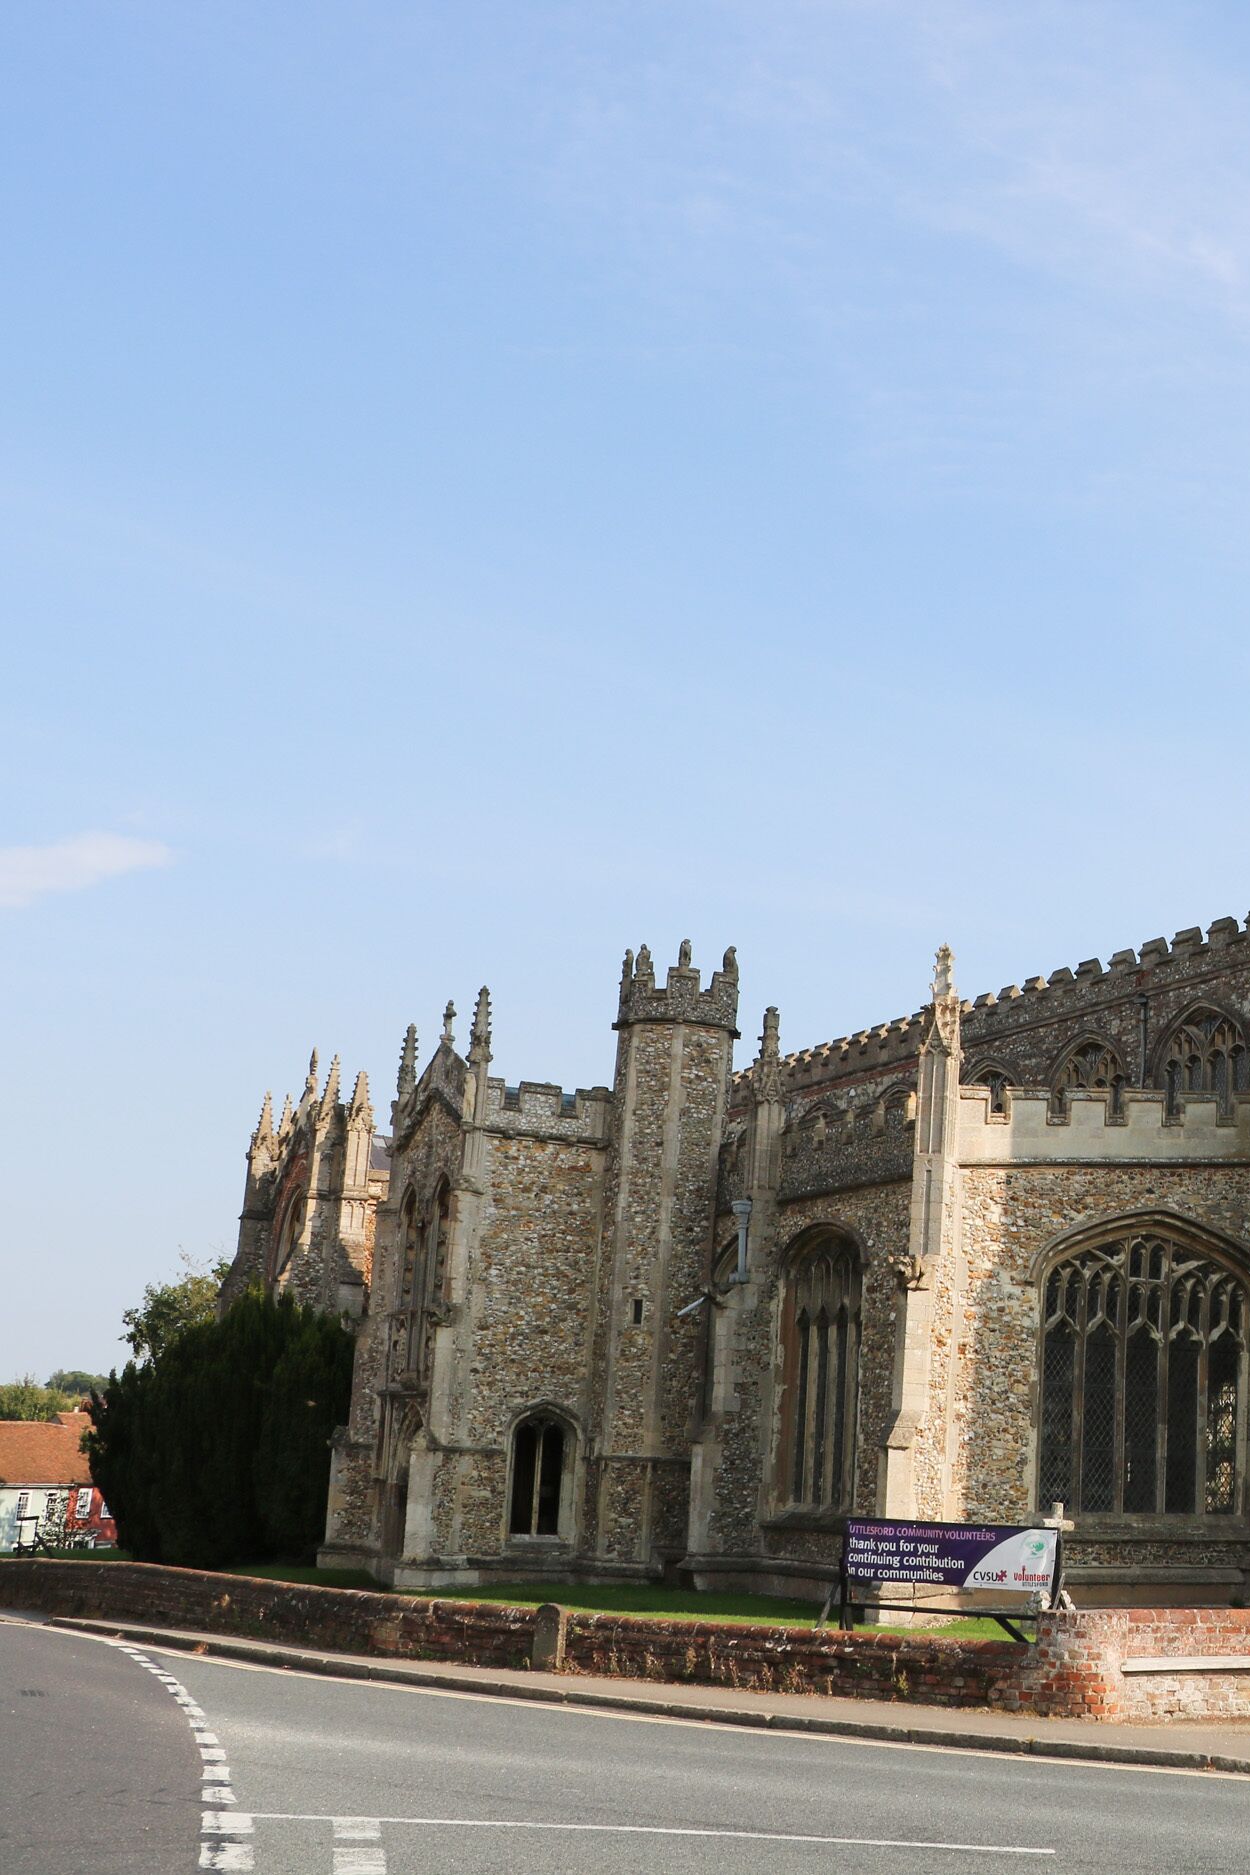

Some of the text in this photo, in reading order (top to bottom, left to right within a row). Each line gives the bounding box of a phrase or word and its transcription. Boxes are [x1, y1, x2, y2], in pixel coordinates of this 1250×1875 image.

[849, 1524, 996, 1541] UTTLESFORD COMMUNITY VOLUNTEERS
[849, 1537, 939, 1555] thank you for your
[848, 1551, 965, 1569] continuing contribution
[847, 1563, 945, 1582] in our communities
[973, 1571, 998, 1582] CVSU
